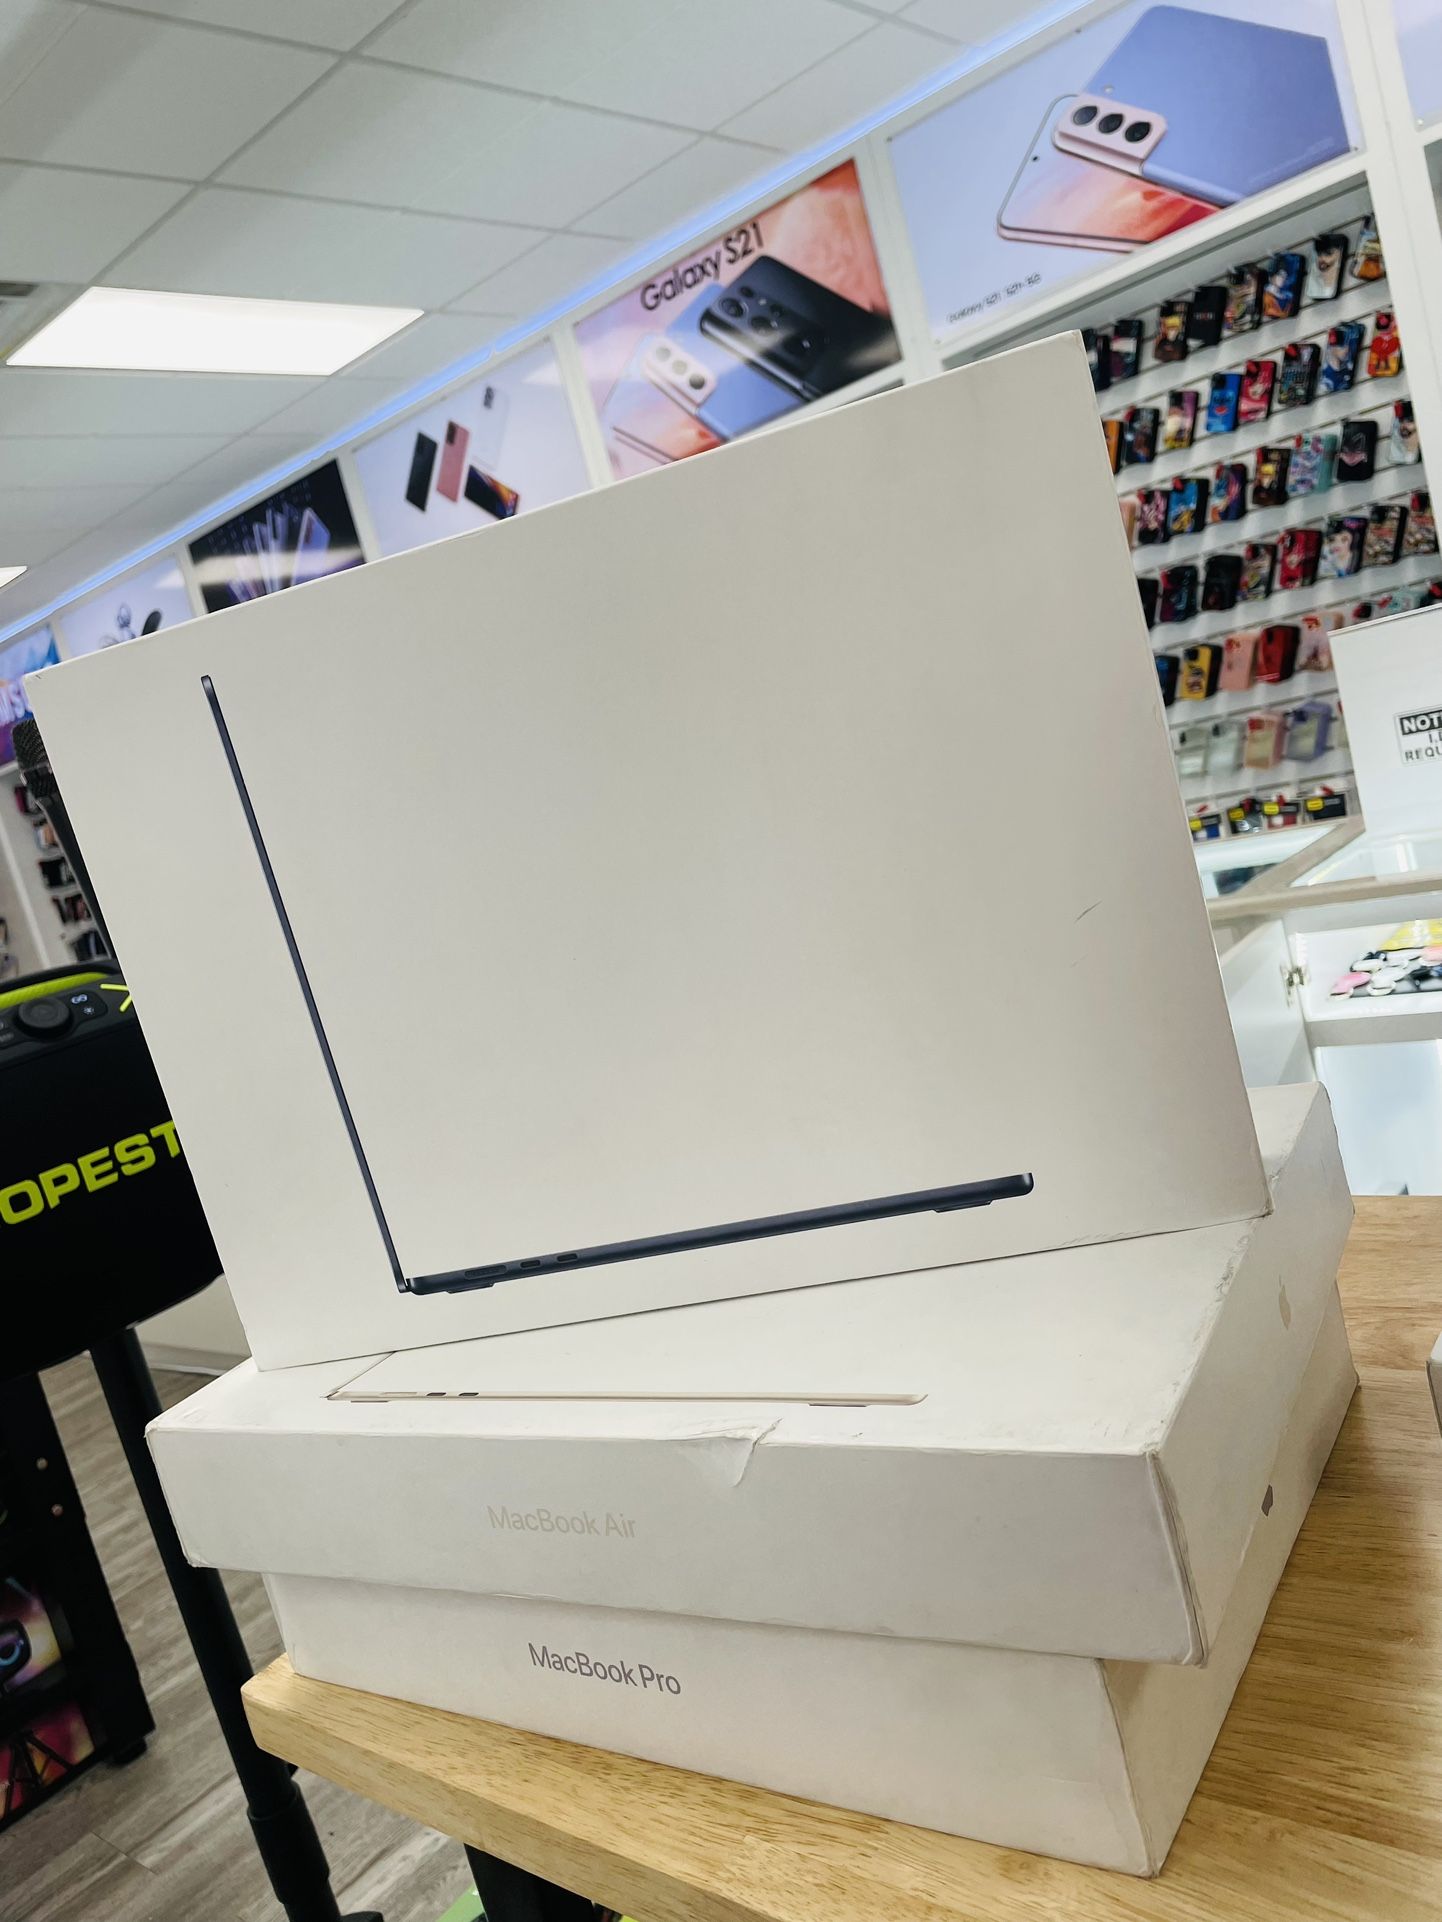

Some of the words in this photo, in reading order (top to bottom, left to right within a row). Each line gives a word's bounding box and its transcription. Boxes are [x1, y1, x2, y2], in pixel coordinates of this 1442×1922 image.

[640, 250, 721, 311] Galaxy
[723, 222, 764, 264] S21
[487, 1505, 601, 1536] MacBook
[605, 1511, 636, 1538] Air
[528, 1642, 638, 1687] MacBook
[638, 1663, 681, 1695] Pro
